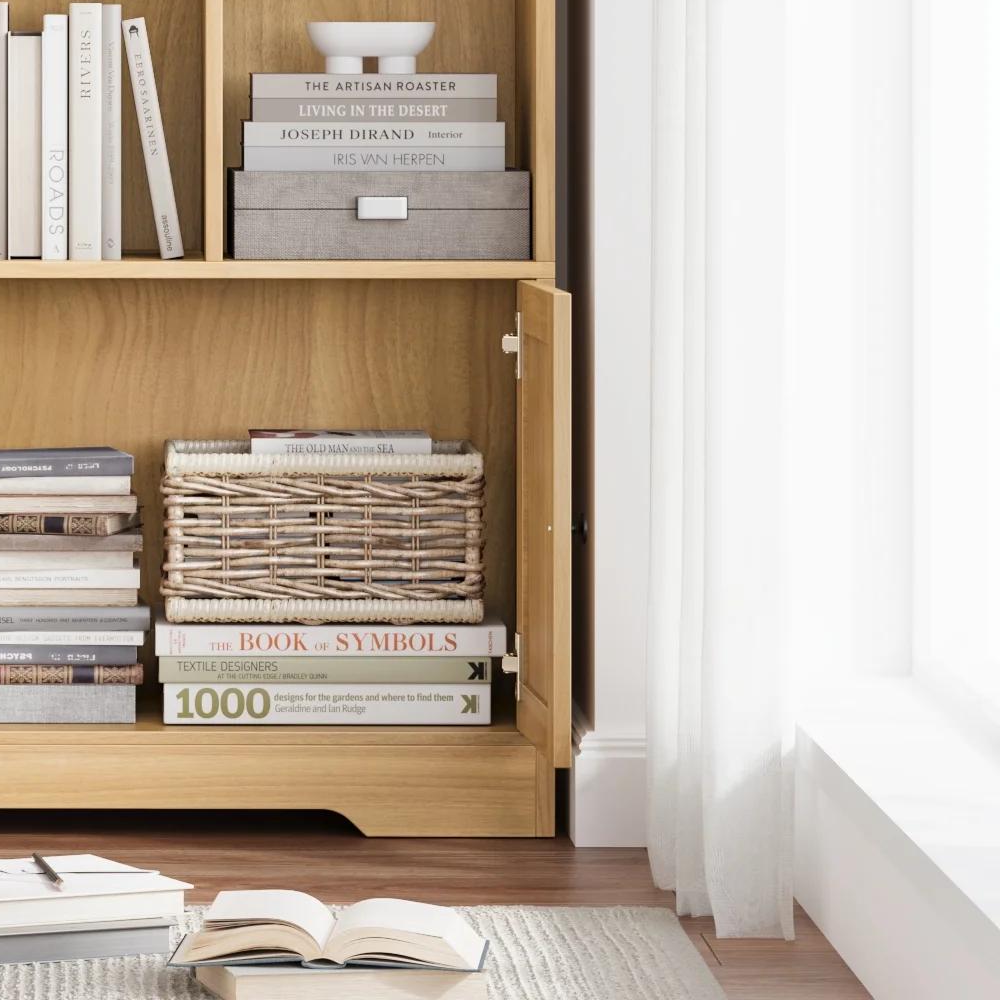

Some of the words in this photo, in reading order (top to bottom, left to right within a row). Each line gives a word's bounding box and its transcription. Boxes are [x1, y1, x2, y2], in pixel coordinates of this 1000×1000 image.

[80, 29, 91, 100] RIVERS
[134, 53, 145, 88] EERO
[305, 81, 329, 91] THE
[335, 81, 392, 91] ARTISAN
[396, 81, 456, 91] ROASTER
[298, 105, 346, 117] LIVING
[350, 105, 366, 117] IN
[369, 105, 395, 117] THE
[399, 105, 448, 117] DESERT
[139, 89, 159, 156] SAARINEN
[280, 129, 344, 141] JOSEPH
[350, 129, 415, 141] DIRAND
[428, 130, 464, 139] Interior
[333, 153, 357, 166] IRIS
[361, 153, 388, 166] VAN
[393, 153, 445, 166] HERPEN
[48, 150, 65, 235] ROADS
[160, 214, 173, 252] assouline
[285, 443, 302, 454] THE
[305, 443, 326, 454] OLD
[328, 443, 349, 454] MAN
[350, 446, 363, 454] AND
[363, 446, 376, 454] THE
[377, 443, 394, 454] SEA
[1, 464, 53, 472] PSYCHOLOGY
[209, 642, 233, 651] THE
[239, 632, 309, 651] BOOK
[314, 642, 330, 651] OF
[335, 632, 457, 652] SYMBOLS
[177, 661, 217, 672] TEXTILE
[220, 661, 279, 672] DESIGNERS
[175, 687, 271, 719] 1000
[274, 693, 304, 702] designs
[305, 693, 317, 701] for
[318, 693, 331, 701] the
[332, 693, 363, 702] gardens
[364, 693, 380, 701] and
[381, 693, 406, 701] where
[416, 693, 432, 701] find
[433, 693, 454, 701] them
[275, 704, 312, 713] Geraldine
[312, 704, 327, 713] and
[342, 704, 366, 714] Rudge
